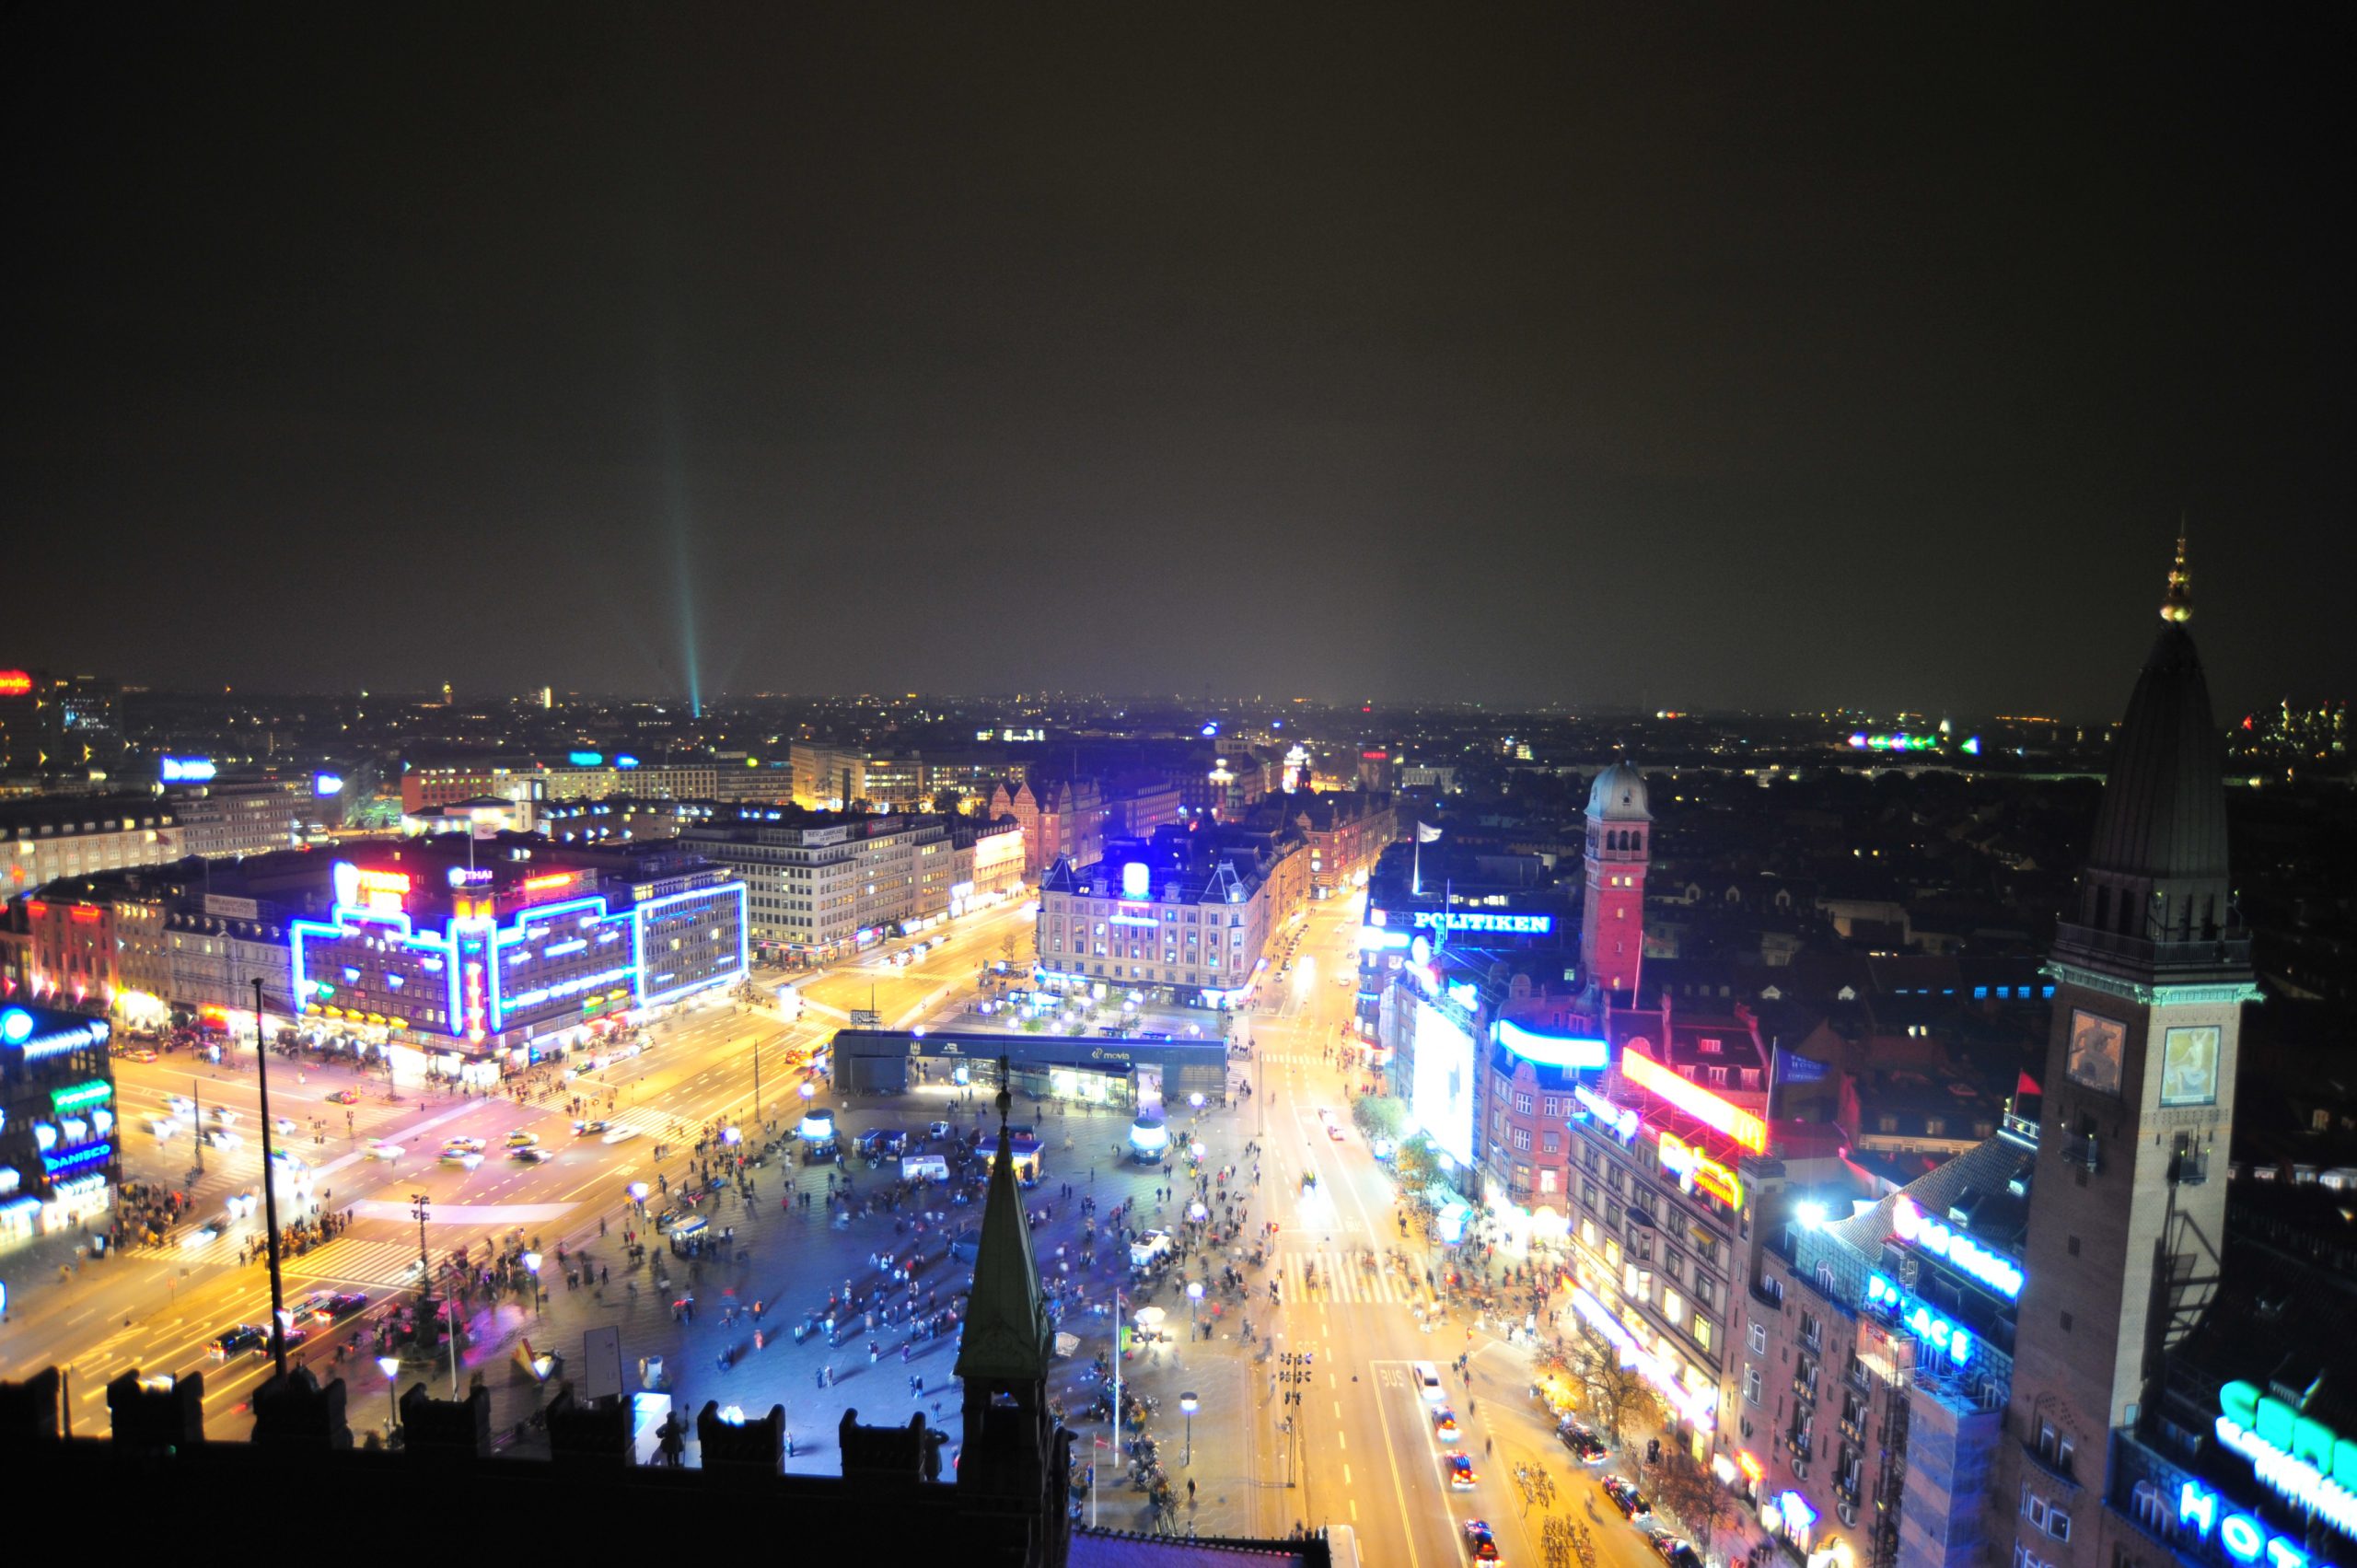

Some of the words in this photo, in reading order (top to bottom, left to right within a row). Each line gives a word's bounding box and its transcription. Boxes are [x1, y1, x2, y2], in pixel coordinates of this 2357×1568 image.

[1414, 912, 1551, 934] POLITIKEN
[45, 1144, 110, 1170] DANISCO
[1380, 1369, 1405, 1388] BUS
[2180, 1481, 2346, 1568] HOT
